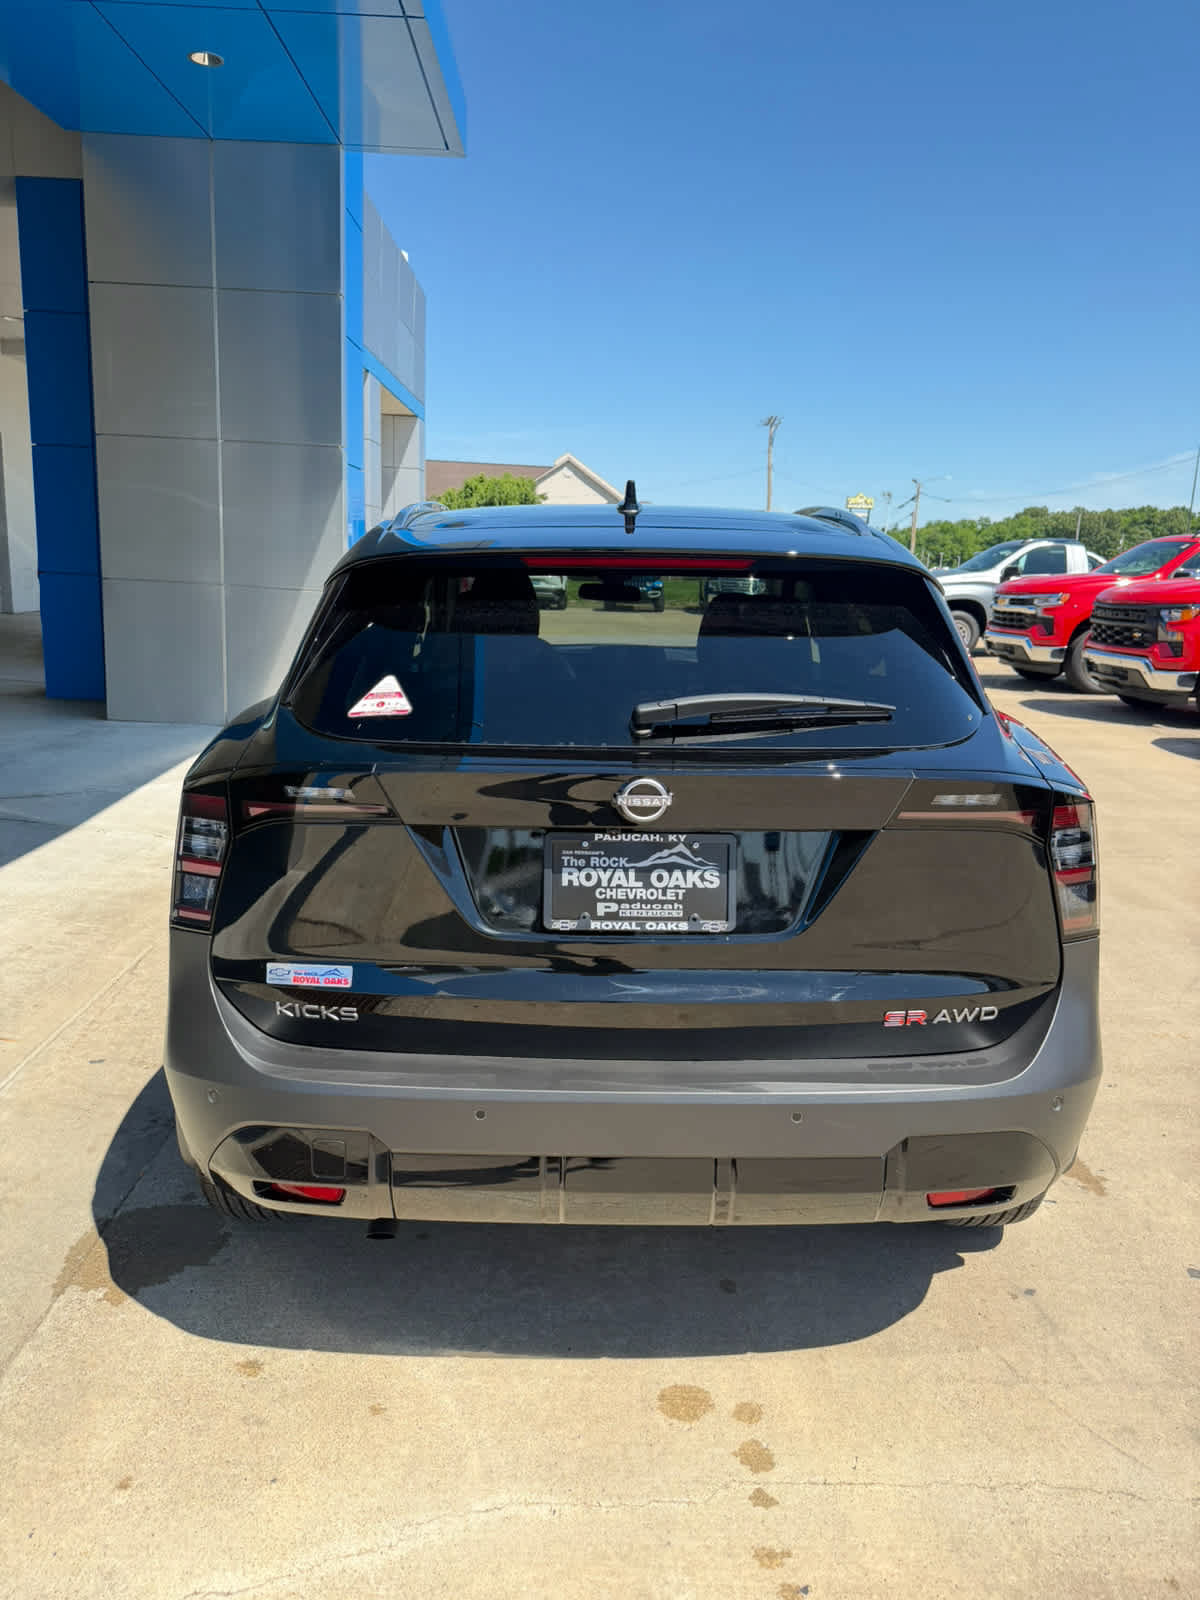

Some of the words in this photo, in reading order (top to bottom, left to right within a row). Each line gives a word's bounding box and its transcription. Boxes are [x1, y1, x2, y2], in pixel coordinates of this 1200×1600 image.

[617, 796, 673, 806] NISSAN
[594, 833, 664, 842] PADUCAH,
[668, 834, 687, 842] KY
[561, 856, 586, 867] The
[590, 857, 629, 868] ROCK
[561, 867, 644, 887] ROYAL
[650, 869, 721, 888] OAKS
[595, 888, 686, 900] CHEVROLET
[596, 902, 683, 916] Paducah
[591, 921, 641, 930] ROYAL
[645, 921, 688, 930] OAKS
[292, 976, 321, 985] ROYAL
[323, 977, 349, 986] OAKS
[275, 1001, 359, 1021] KICKS
[883, 1009, 928, 1027] SR
[932, 1006, 998, 1024] AWD
